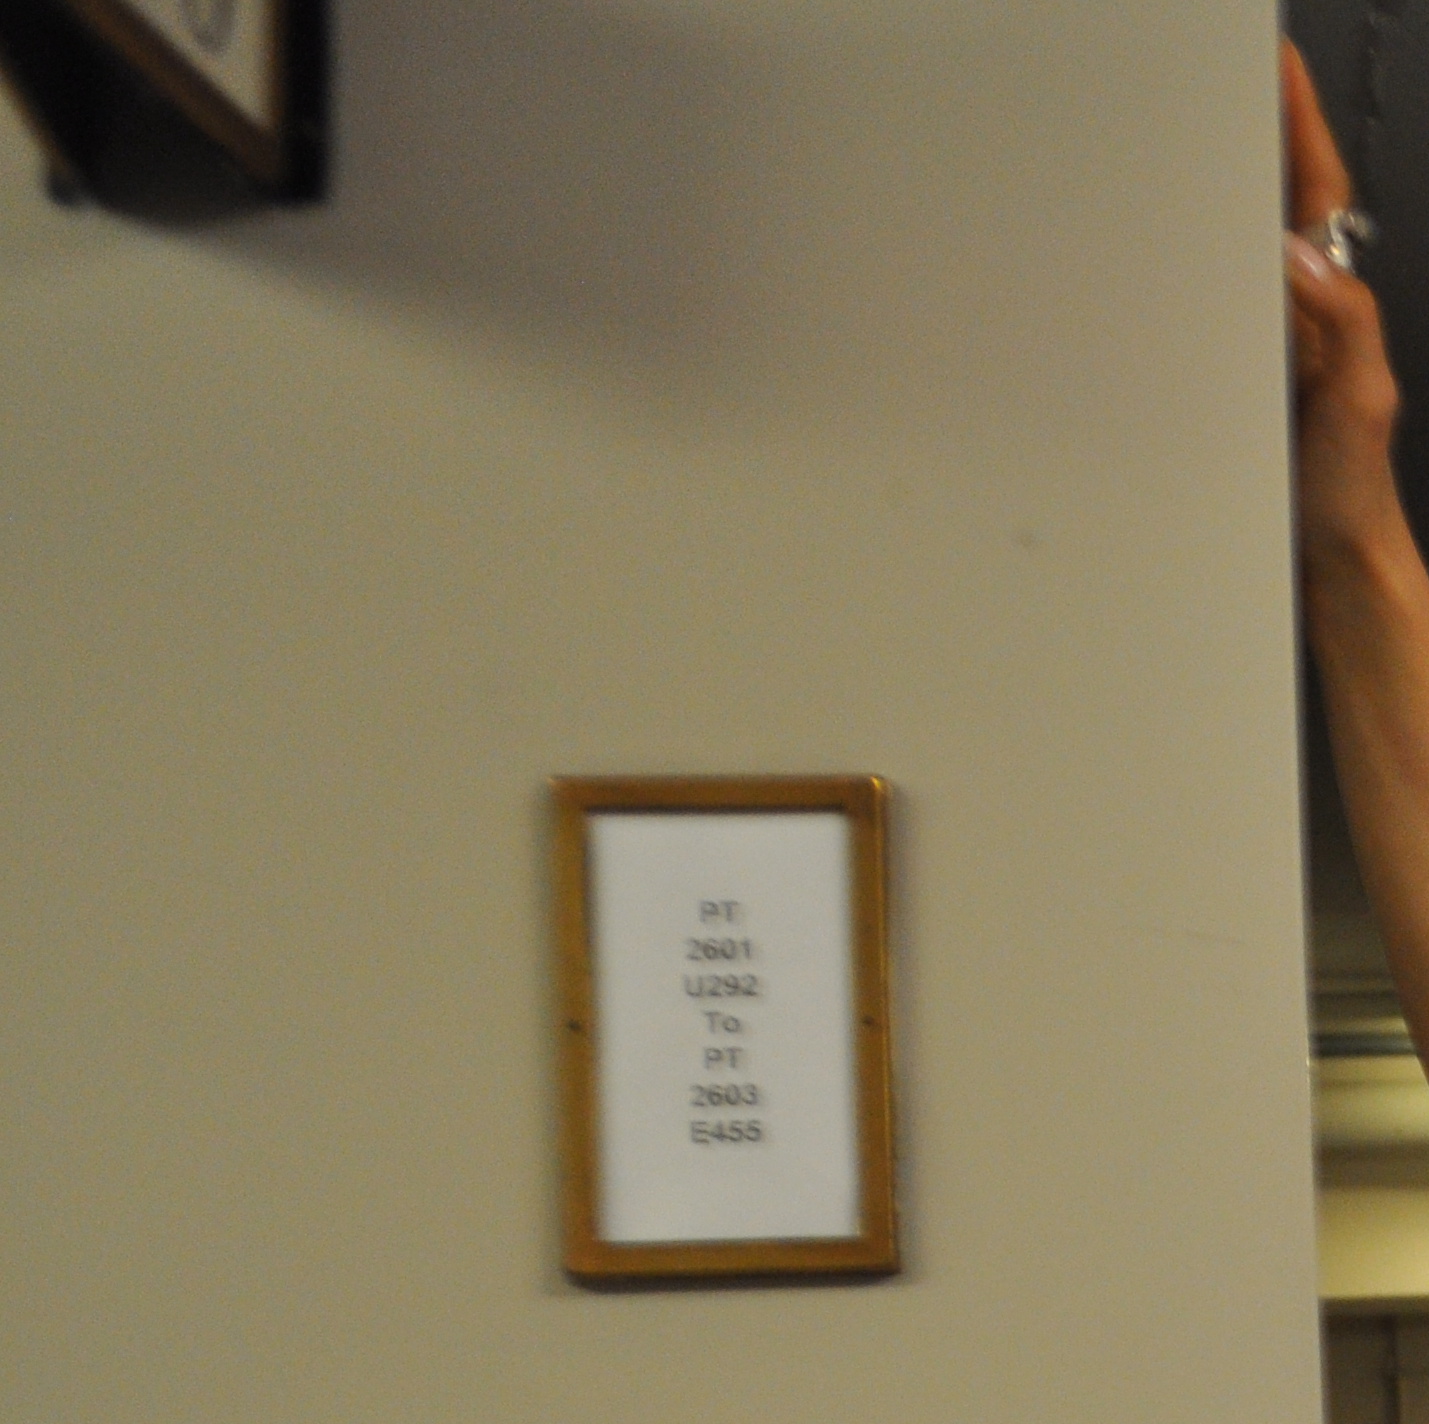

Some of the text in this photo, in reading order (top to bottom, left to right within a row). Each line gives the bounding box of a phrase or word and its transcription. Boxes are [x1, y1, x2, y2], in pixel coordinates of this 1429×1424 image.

[699, 900, 739, 924] PT
[685, 938, 752, 960] 2601
[683, 973, 760, 998] U292
[704, 1010, 742, 1033] To
[703, 1047, 744, 1070] PT
[689, 1083, 760, 1107] 2603
[690, 1119, 763, 1145] E455
